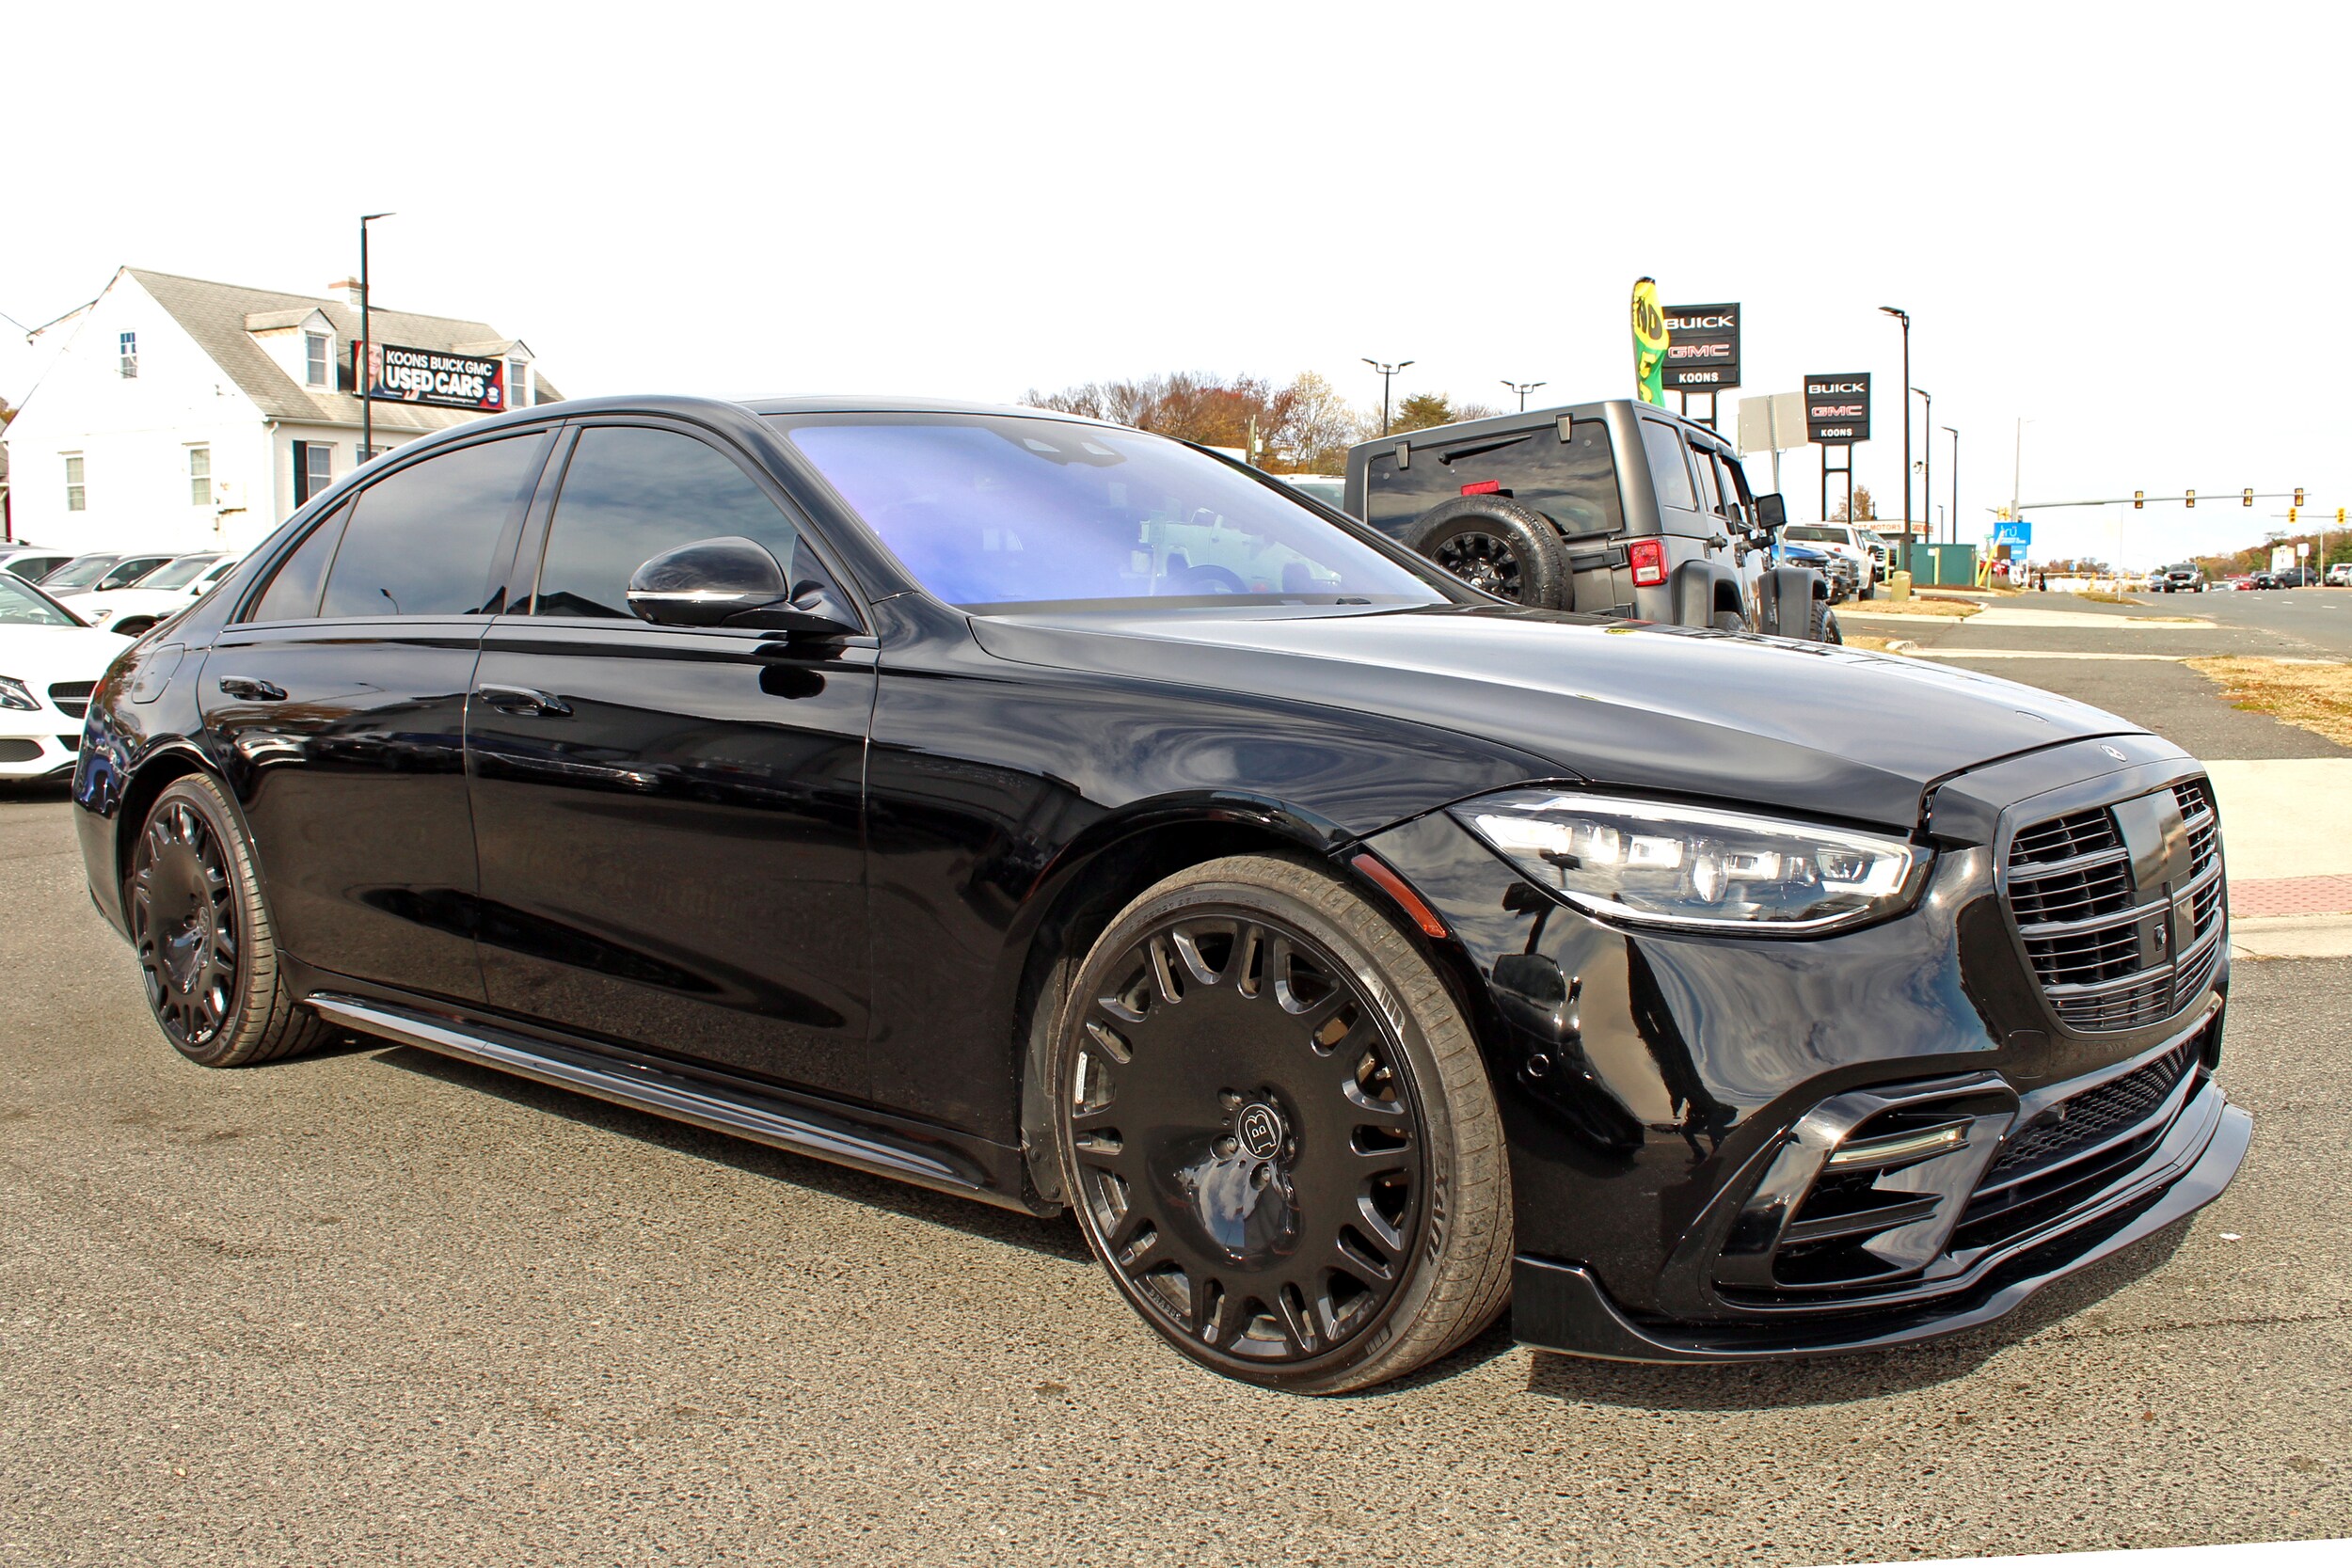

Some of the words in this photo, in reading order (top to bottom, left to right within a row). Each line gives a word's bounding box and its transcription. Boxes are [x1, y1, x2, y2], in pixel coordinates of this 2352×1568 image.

[1663, 315, 1735, 330] BUICK
[1668, 344, 1729, 358] GMC
[386, 350, 428, 368] KOONS
[430, 356, 465, 373] BUICK
[465, 360, 492, 376] GMC
[386, 365, 434, 392] USED
[435, 372, 485, 398] CARS
[1678, 372, 1719, 383] KOONS
[1808, 383, 1866, 394] BUICK
[1811, 405, 1863, 417] GMC
[1820, 428, 1852, 437] KOONS
